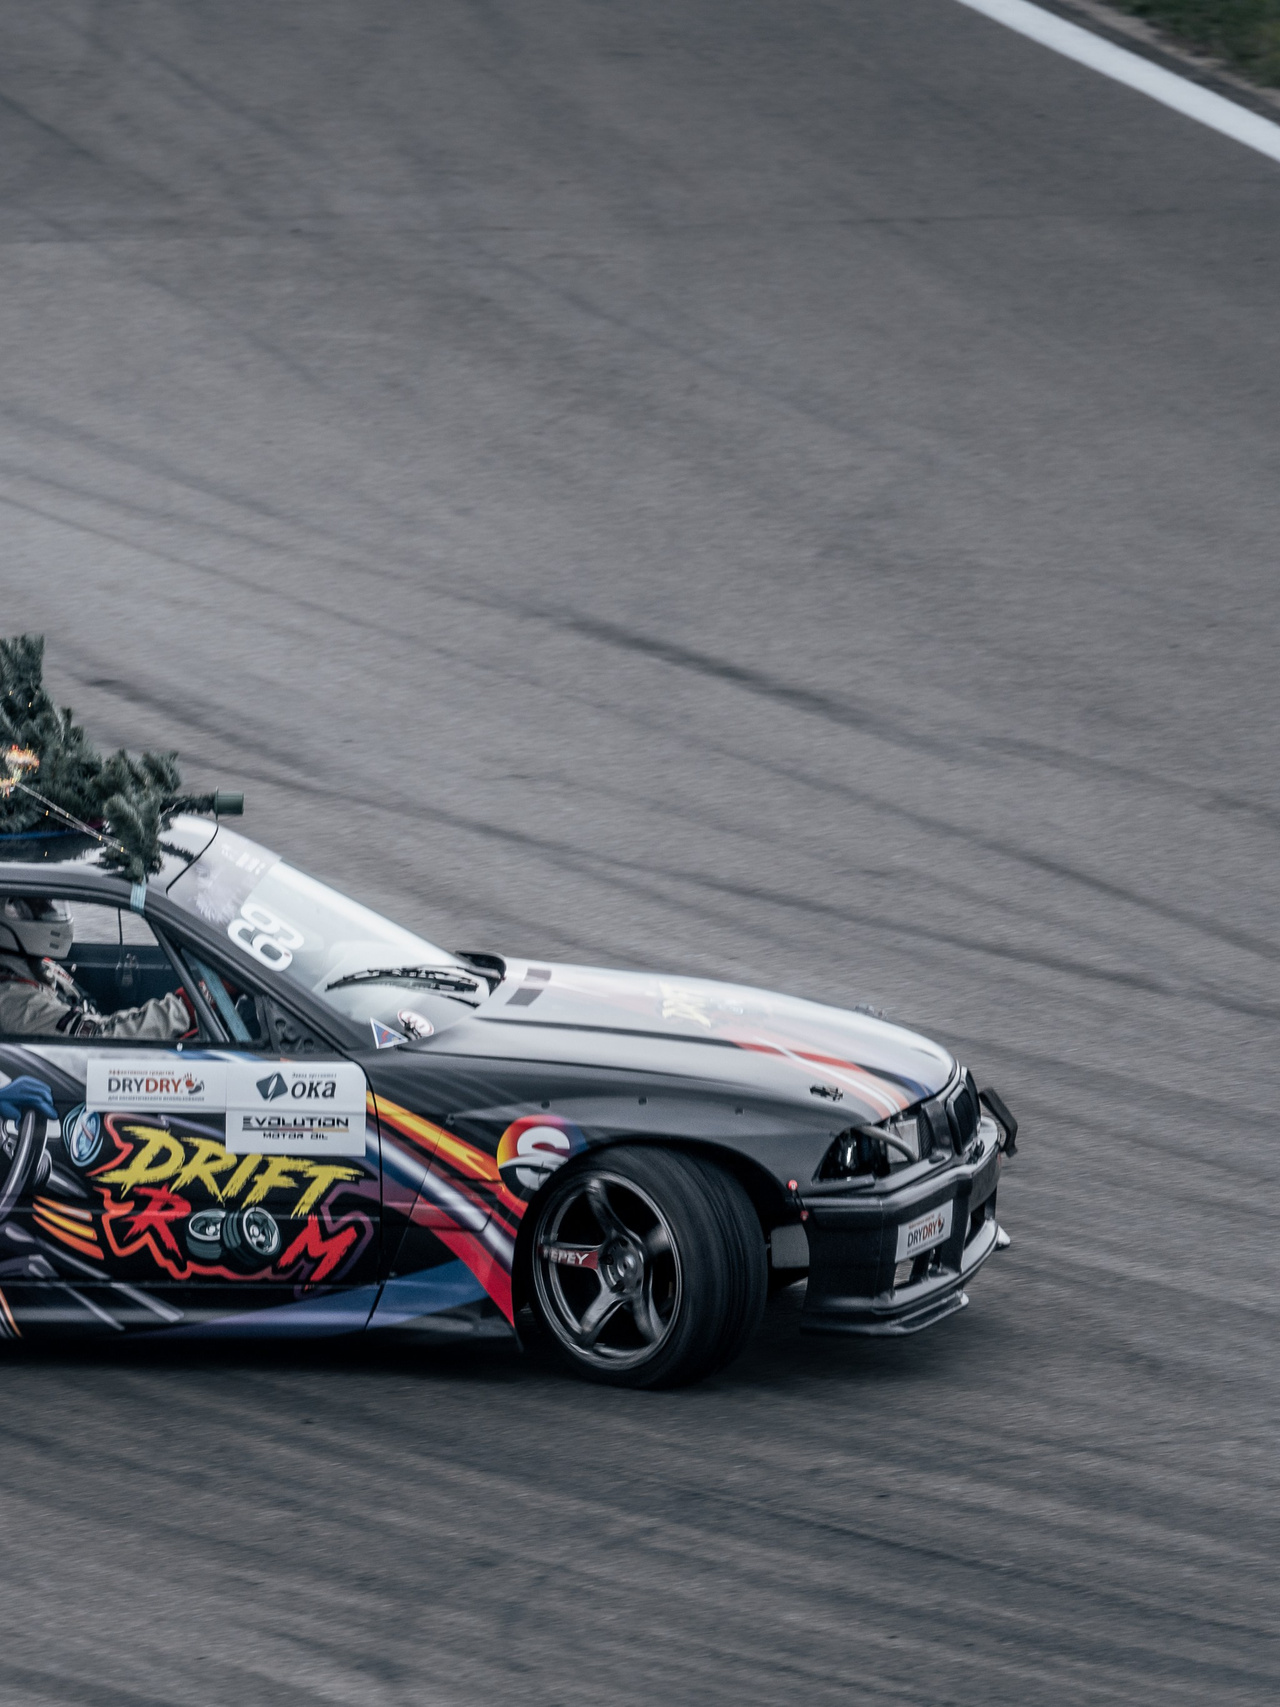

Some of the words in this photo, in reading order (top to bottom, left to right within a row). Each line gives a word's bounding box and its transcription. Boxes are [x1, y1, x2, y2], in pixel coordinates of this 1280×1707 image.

[108, 1078, 181, 1094] DRYDRY
[242, 1115, 349, 1129] EVOLUTION
[263, 1132, 303, 1140] MOTOR
[310, 1132, 328, 1140] OIL
[92, 1125, 365, 1220] DRIFT
[907, 1219, 937, 1247] DRYDRY
